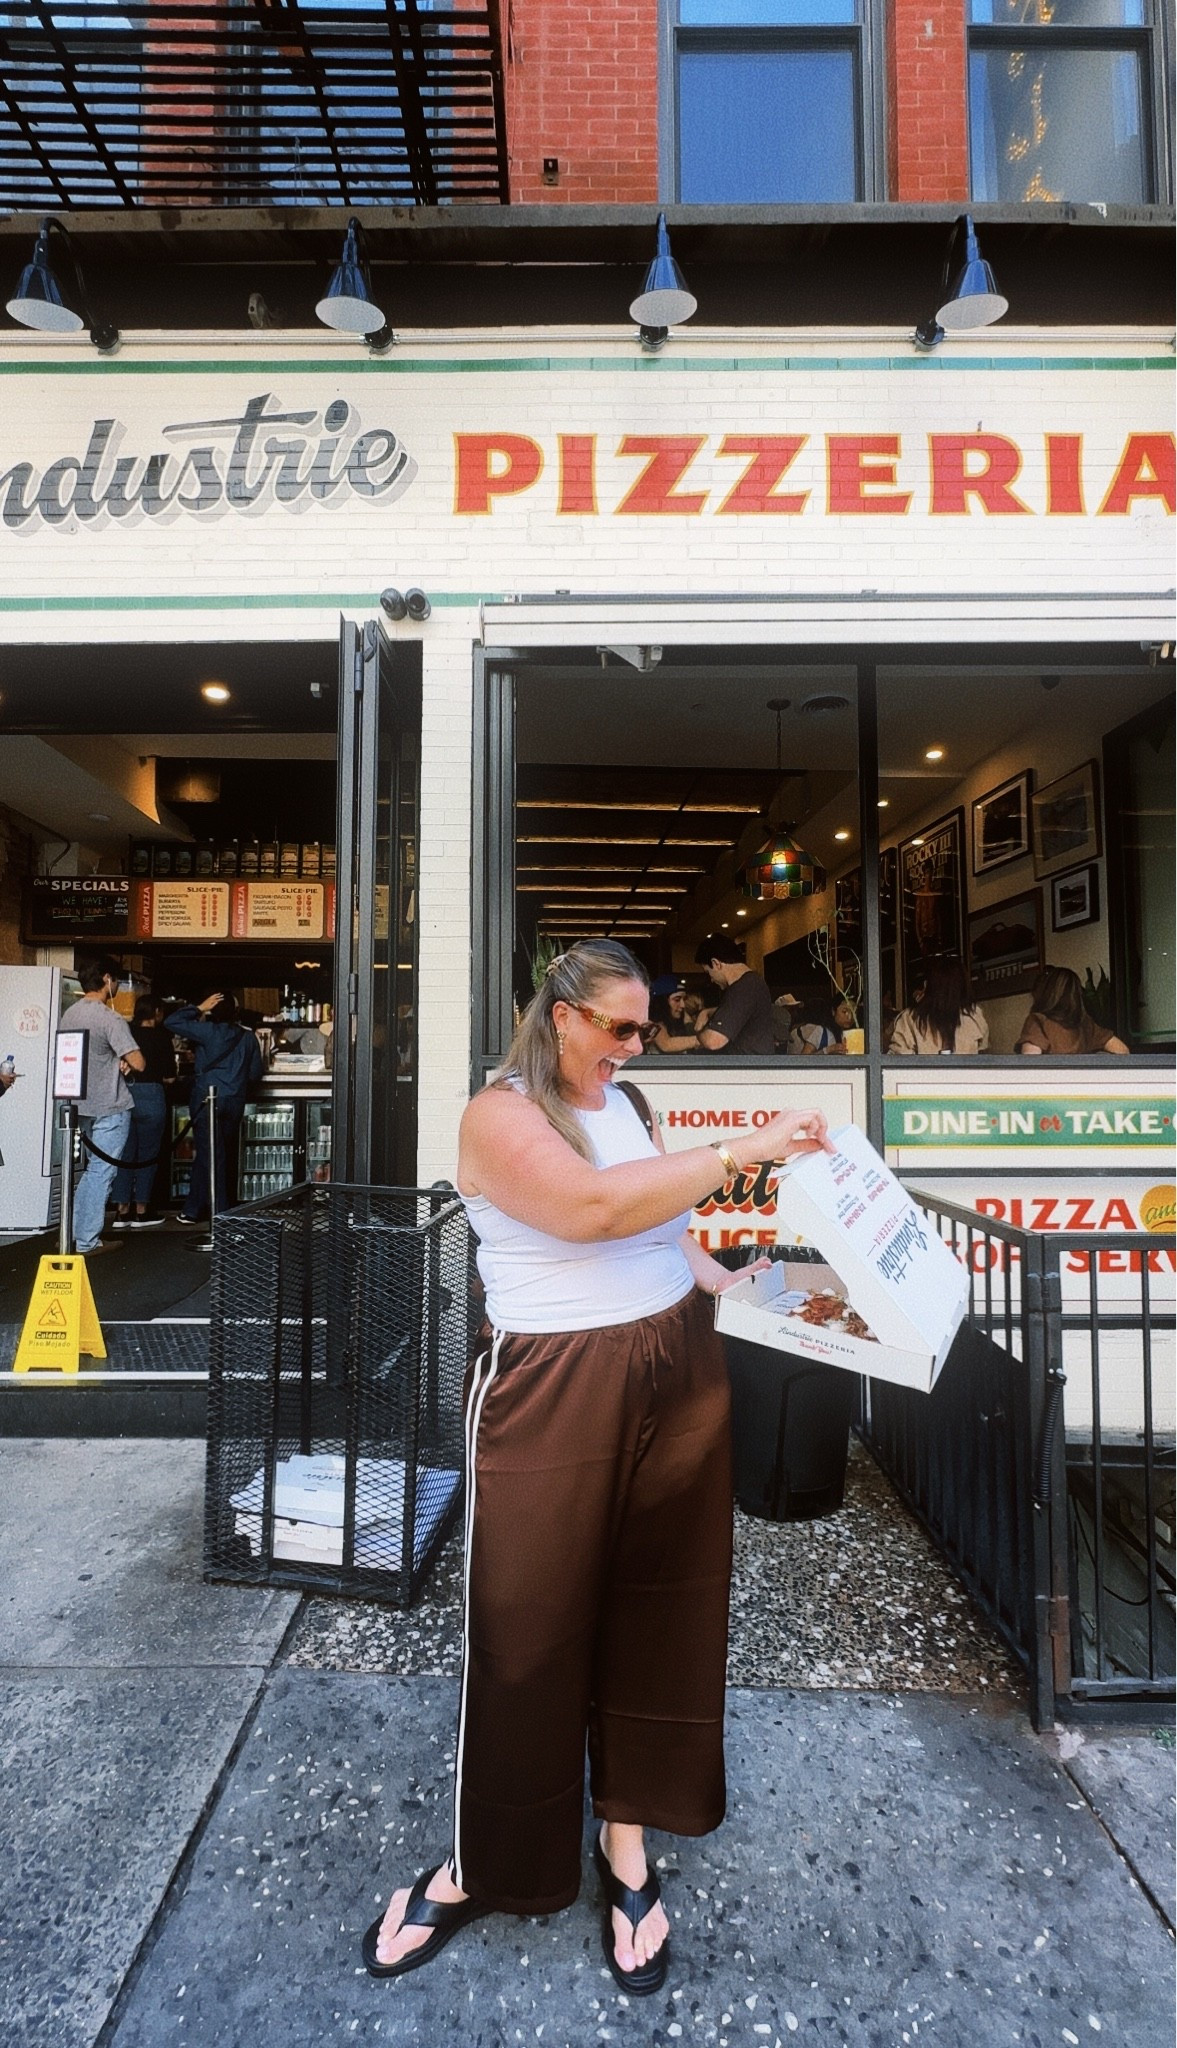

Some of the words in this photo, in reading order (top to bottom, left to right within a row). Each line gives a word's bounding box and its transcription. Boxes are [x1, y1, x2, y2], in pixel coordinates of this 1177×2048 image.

[452, 431, 1176, 516] PIZZERIA
[51, 880, 130, 891] SPECIALS
[143, 886, 151, 915] PIZZA
[237, 886, 245, 914] PIZZA
[668, 1110, 748, 1127] HOME
[976, 1198, 1137, 1230] PIZZA
[872, 1215, 899, 1246] PIZZERIA
[36, 1331, 67, 1339] Cuidado
[45, 1340, 71, 1348] Mojado
[815, 1338, 855, 1355] PIZZERIA
